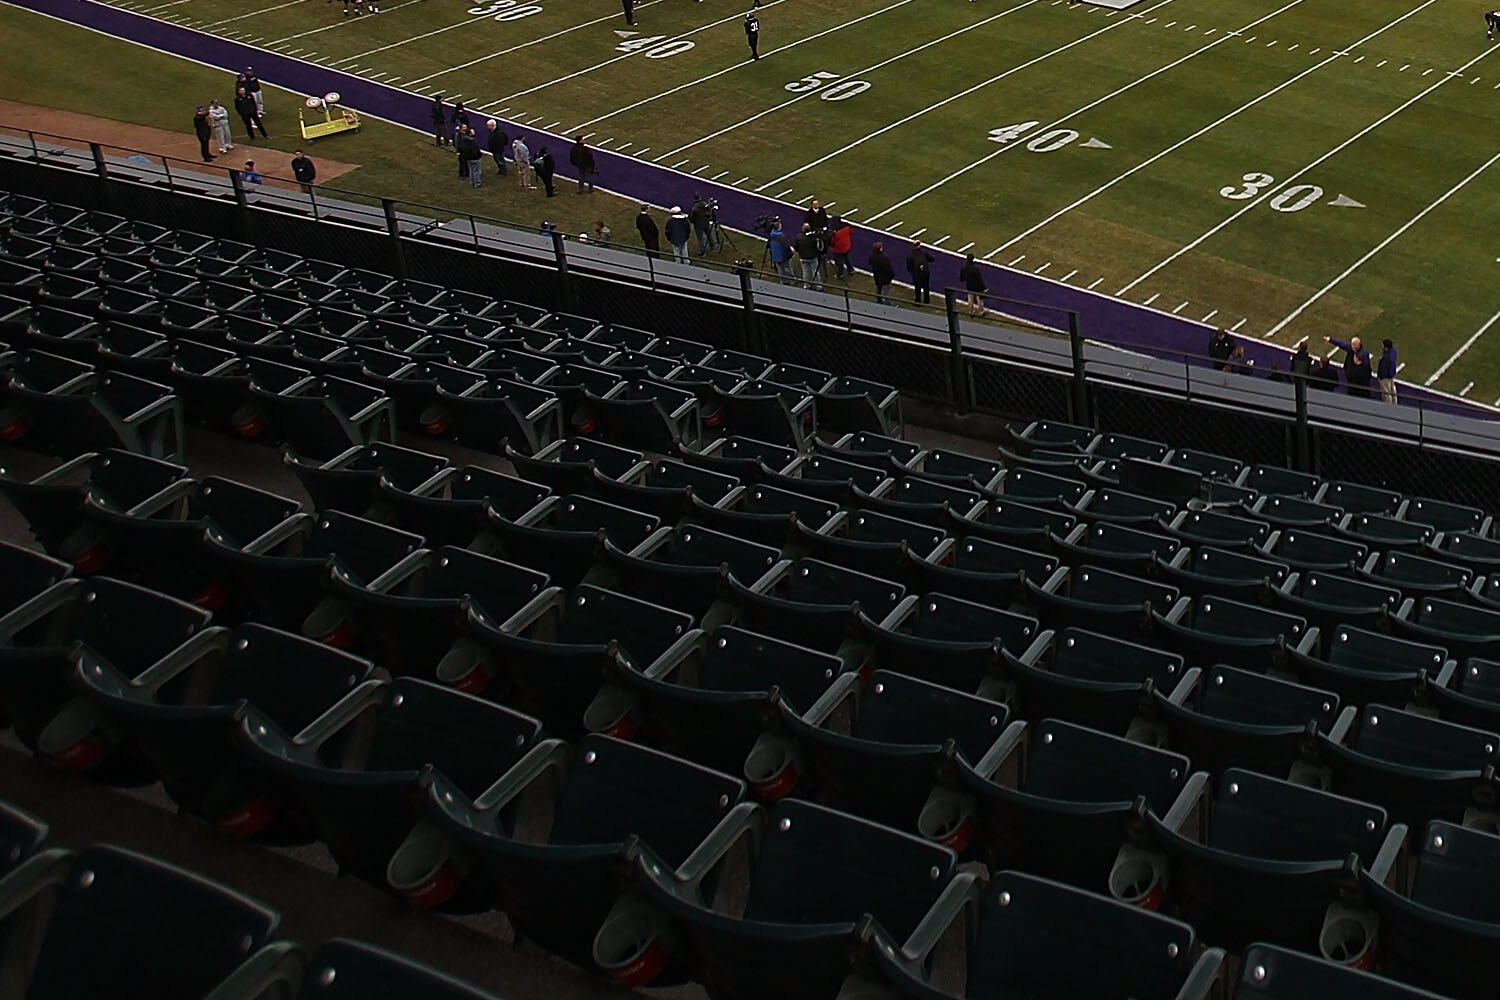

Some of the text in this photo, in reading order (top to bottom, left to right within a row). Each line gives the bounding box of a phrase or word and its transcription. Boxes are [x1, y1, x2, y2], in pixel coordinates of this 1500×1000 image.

[467, 0, 544, 21] 30
[615, 35, 696, 59] 40
[784, 71, 871, 101] 50
[988, 121, 1080, 153] 40
[1220, 172, 1324, 212] 30
